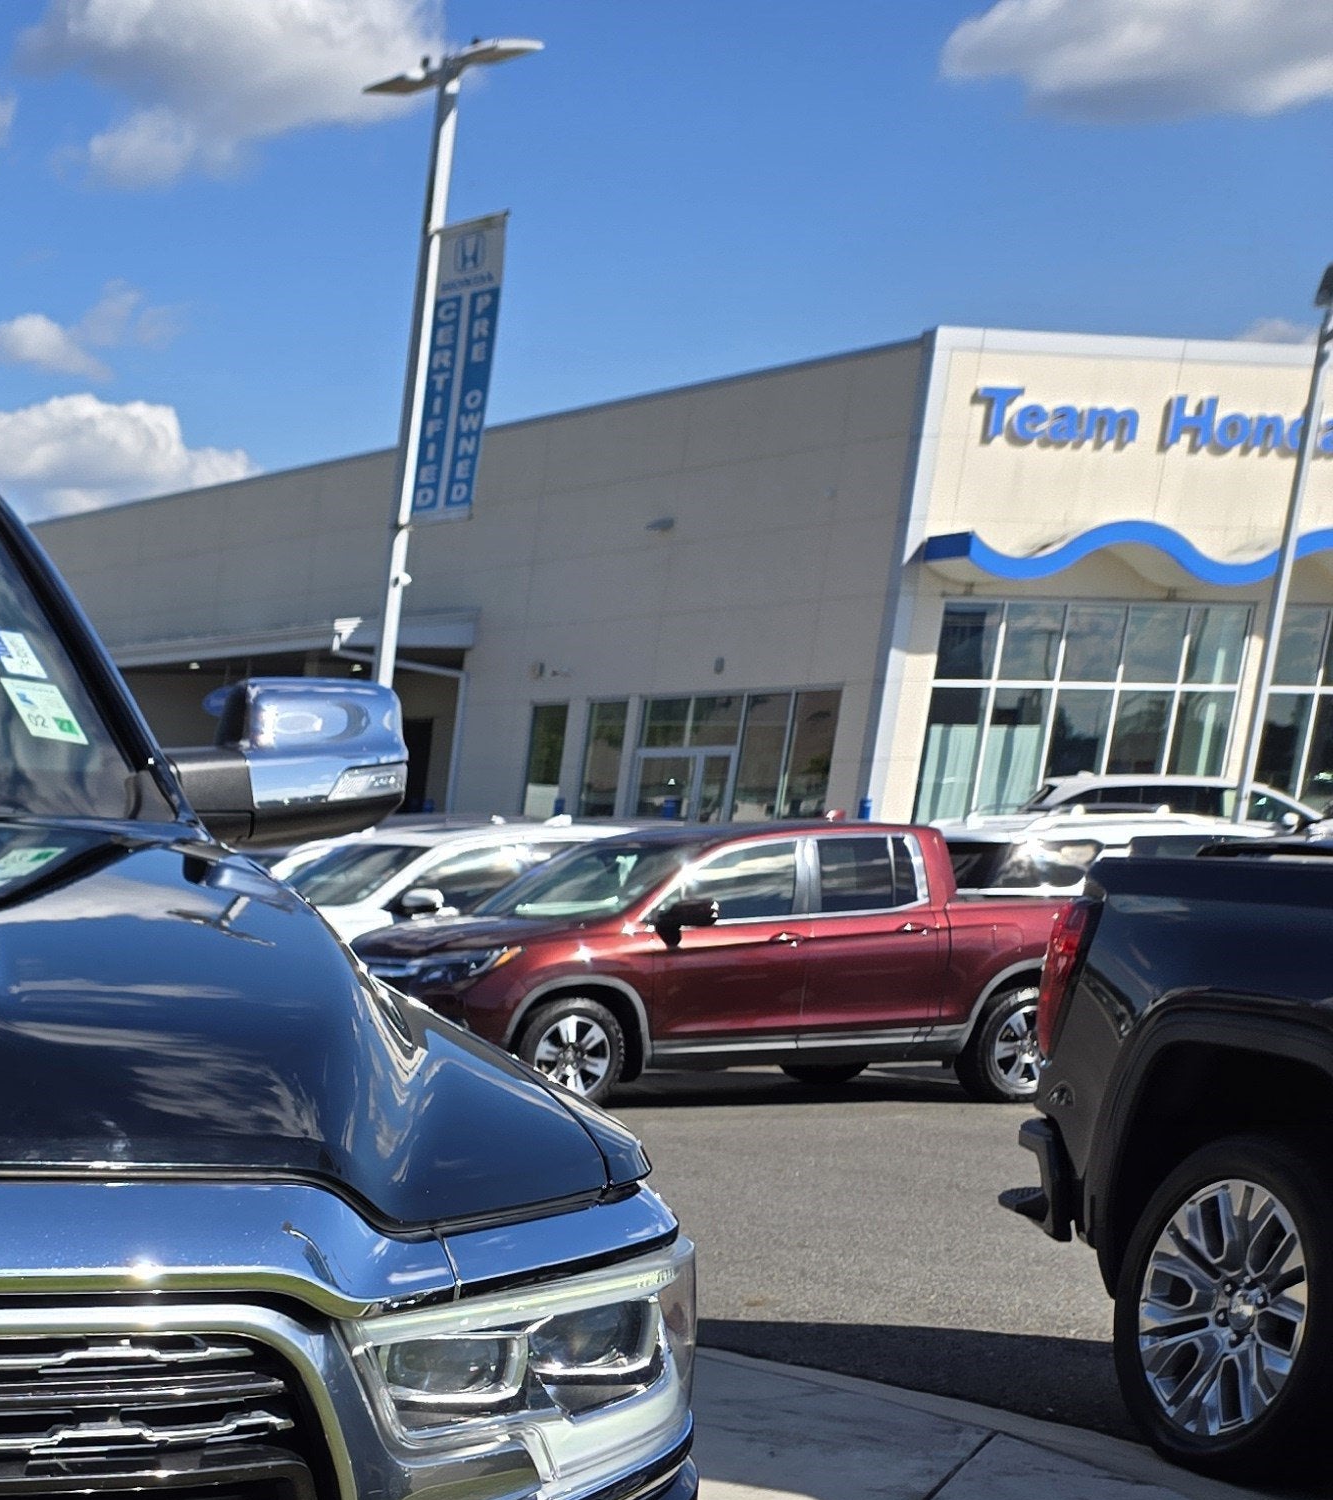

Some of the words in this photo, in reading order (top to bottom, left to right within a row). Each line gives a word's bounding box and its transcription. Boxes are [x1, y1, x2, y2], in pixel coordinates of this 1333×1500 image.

[470, 293, 493, 363] PRE
[415, 301, 457, 507] CERTIFIED
[450, 388, 483, 503] OWNED
[974, 386, 1140, 445] Team
